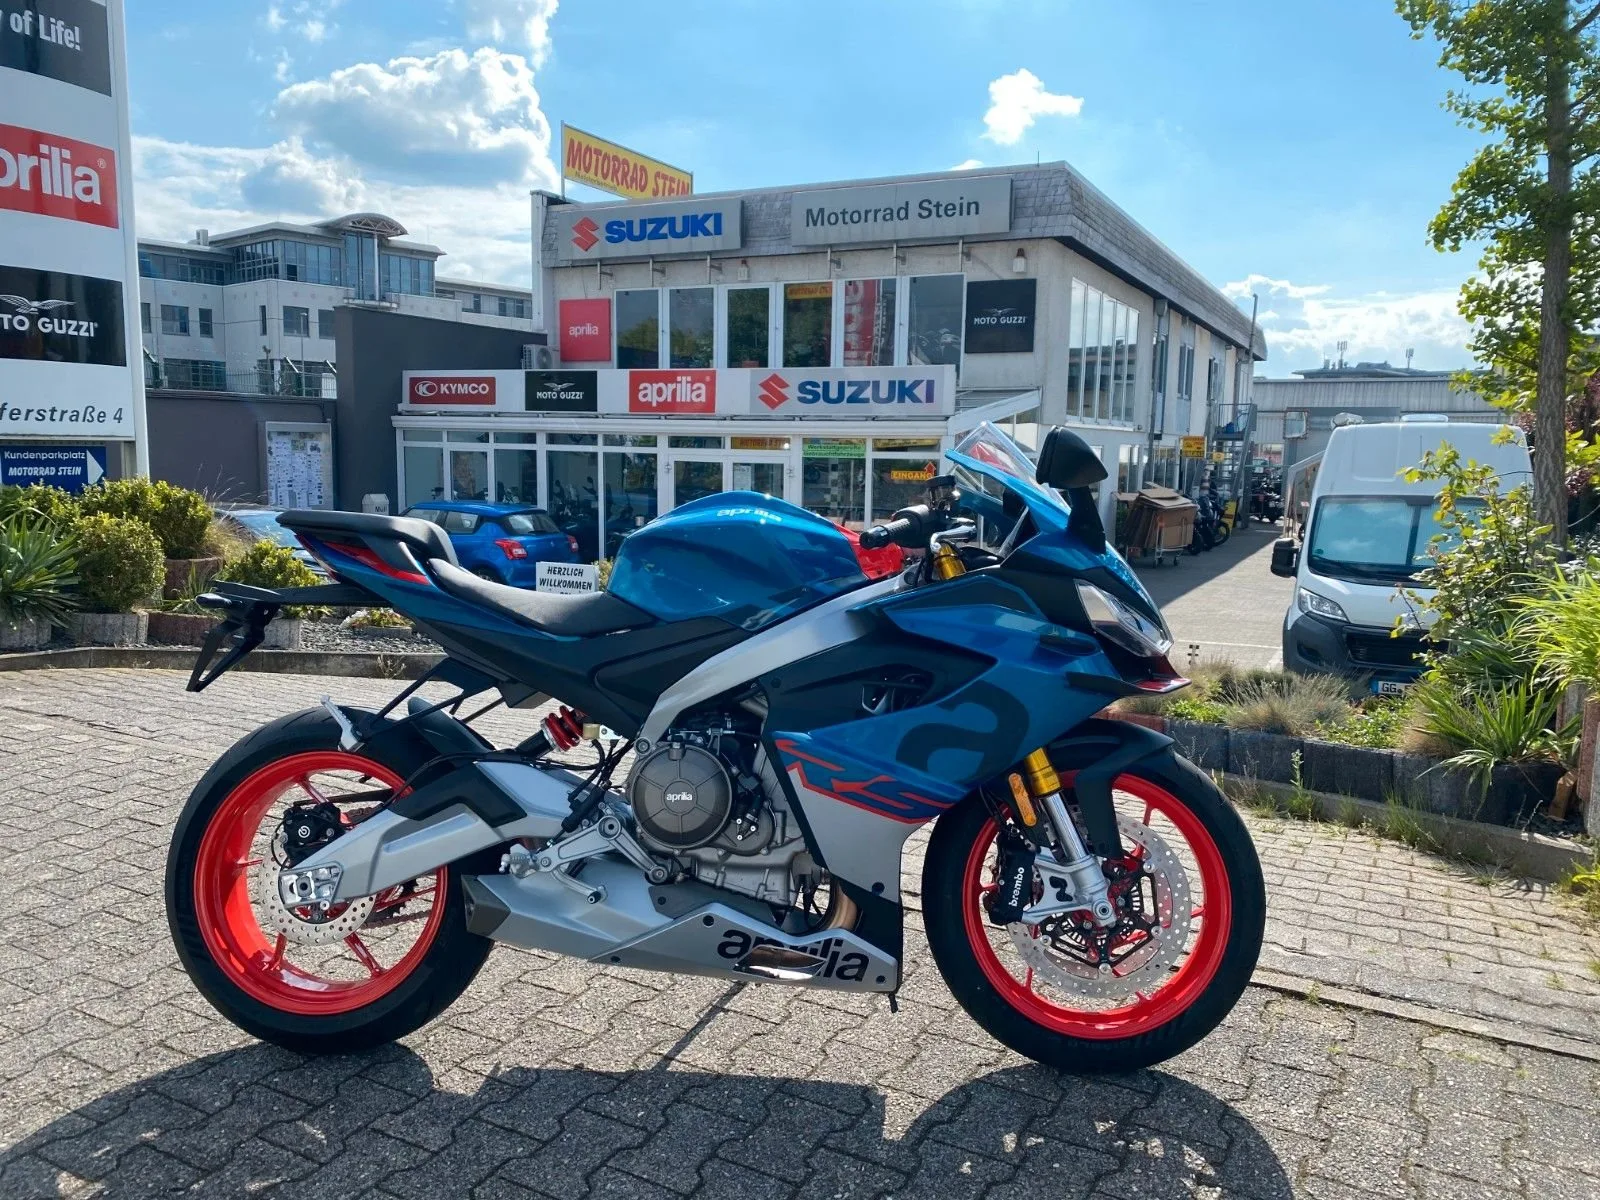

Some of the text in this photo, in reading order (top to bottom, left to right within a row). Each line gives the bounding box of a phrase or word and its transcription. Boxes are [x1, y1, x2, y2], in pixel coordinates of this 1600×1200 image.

[10, 10, 81, 51] of Life!
[566, 138, 649, 193] MOTORRAD
[805, 196, 980, 228] Motorrad Stein
[605, 212, 722, 244] SUZUKI
[37, 317, 95, 338] GUZZI
[973, 316, 1026, 325] MOTO GUZZI
[568, 323, 599, 338] aprilia
[440, 383, 490, 395] KYMCO
[536, 391, 583, 400] MOTO GUZZI
[638, 375, 706, 408] aprilia
[797, 379, 935, 404] SUZUKI
[113, 407, 124, 424] 4
[4, 450, 86, 460] Kundenparkplatz
[8, 466, 82, 476] MOTORRAD STEIN
[547, 566, 584, 577] HERZLICH
[539, 577, 593, 591] WILLKOMMEN
[666, 791, 693, 803] aprilia
[1008, 867, 1025, 907] brembo
